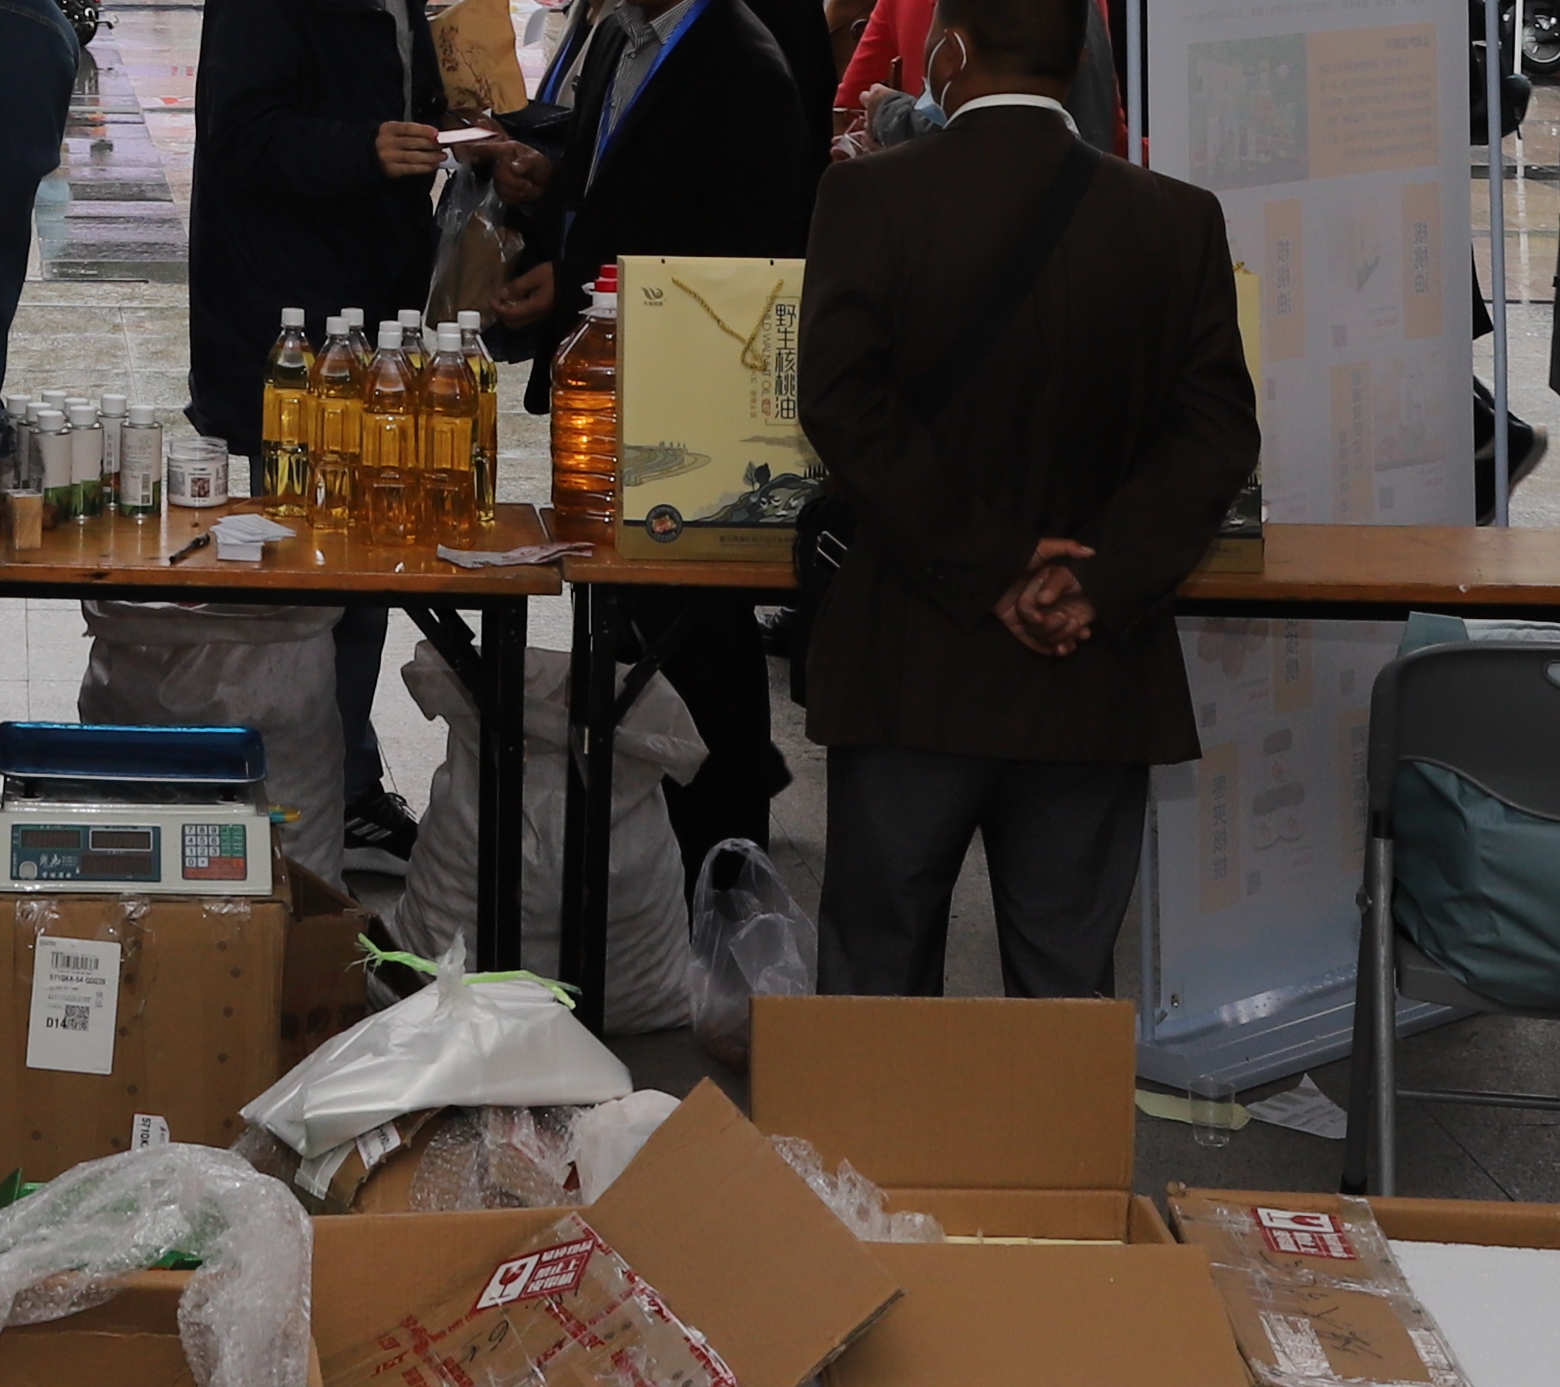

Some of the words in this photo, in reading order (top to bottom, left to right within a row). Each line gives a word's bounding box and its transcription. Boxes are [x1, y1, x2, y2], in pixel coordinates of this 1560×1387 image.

[775, 303, 798, 420] 野生核桃油
